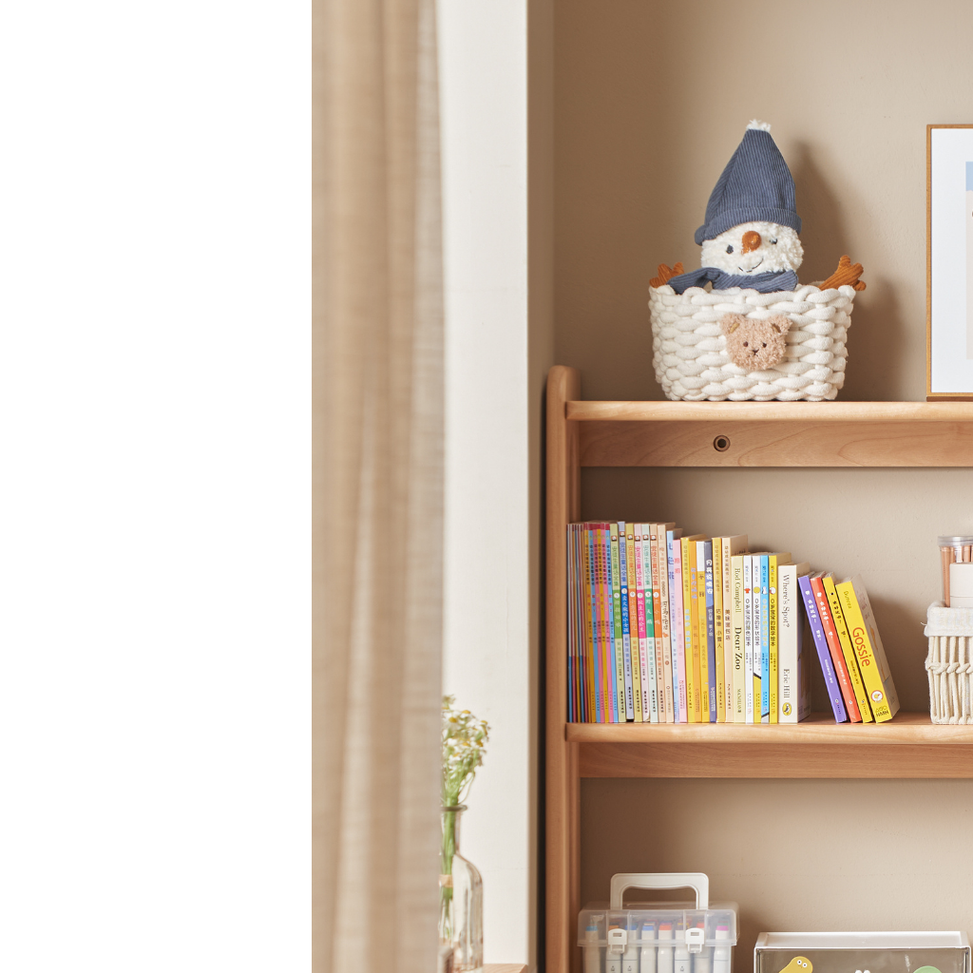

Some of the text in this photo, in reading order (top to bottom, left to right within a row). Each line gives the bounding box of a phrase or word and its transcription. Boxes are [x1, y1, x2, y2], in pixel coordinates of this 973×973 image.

[782, 605, 790, 627] Spot?
[734, 627, 743, 670] Dear Zoo
[852, 627, 872, 667] Gossie
